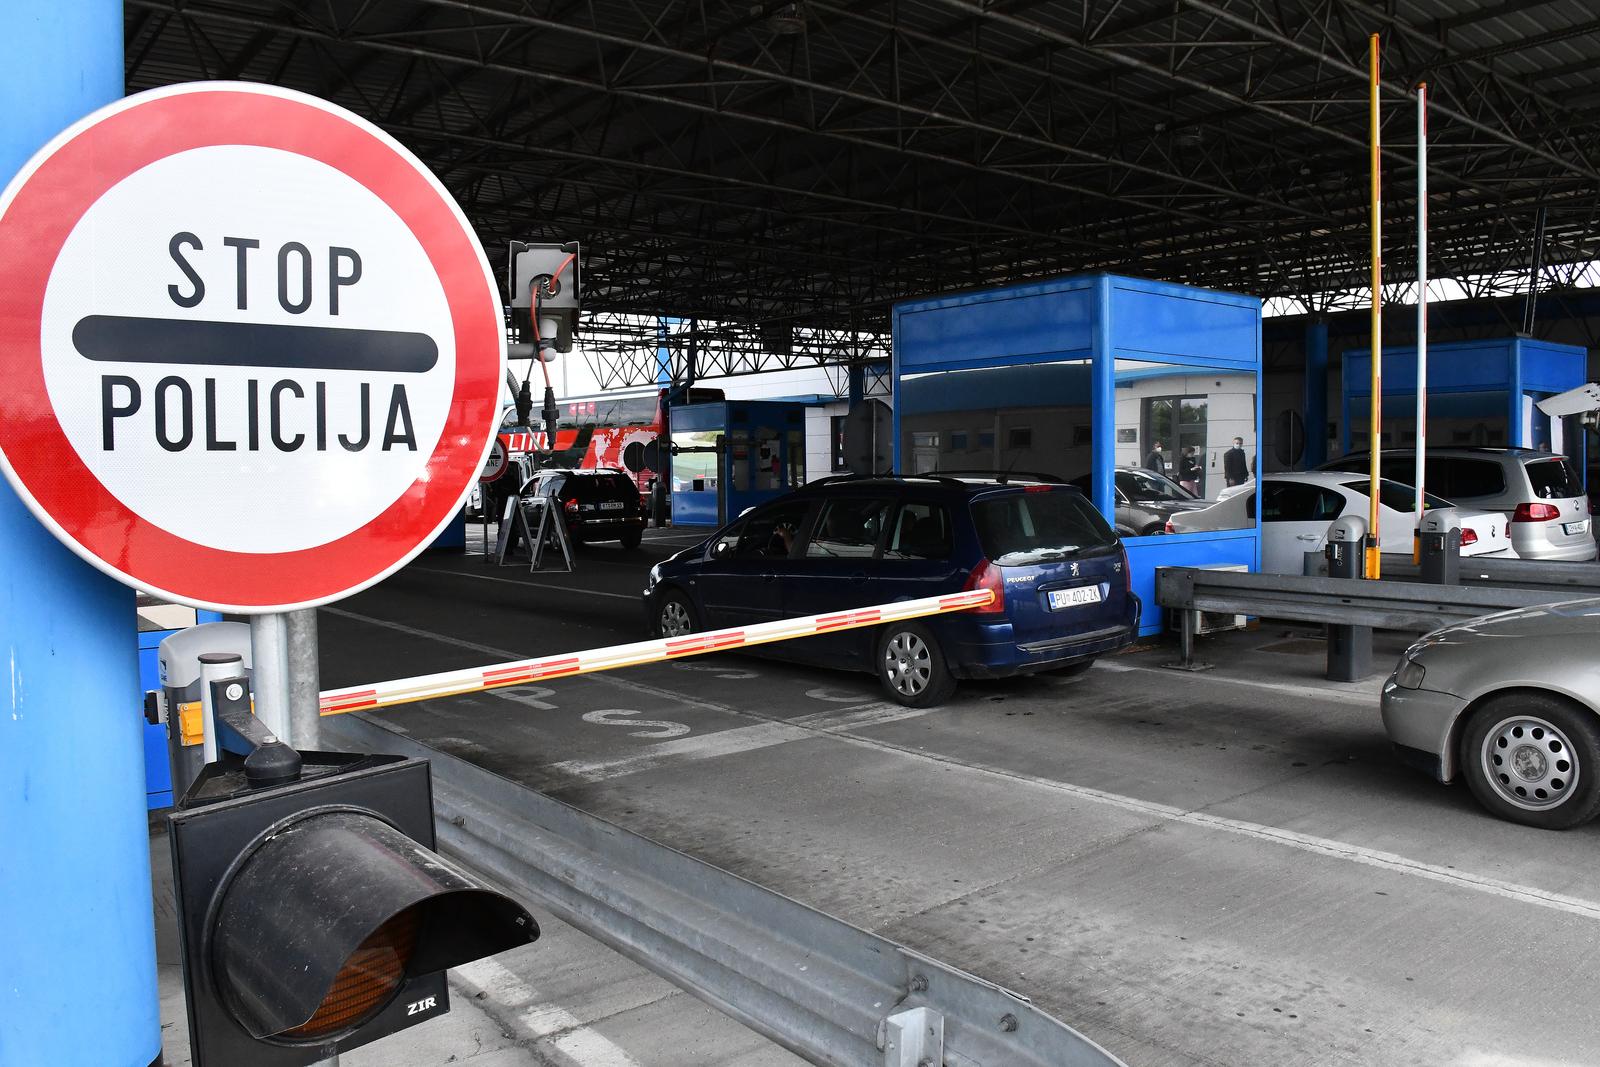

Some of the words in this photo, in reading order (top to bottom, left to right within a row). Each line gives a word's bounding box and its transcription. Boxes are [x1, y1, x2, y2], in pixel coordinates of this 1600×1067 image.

[167, 231, 363, 316] STOP
[101, 374, 418, 453] POLICIJA
[1006, 575, 1035, 583] PEUGEOT
[1055, 591, 1067, 606] PU
[1072, 588, 1099, 603] 402-ZK
[407, 996, 437, 1016] ZIR
